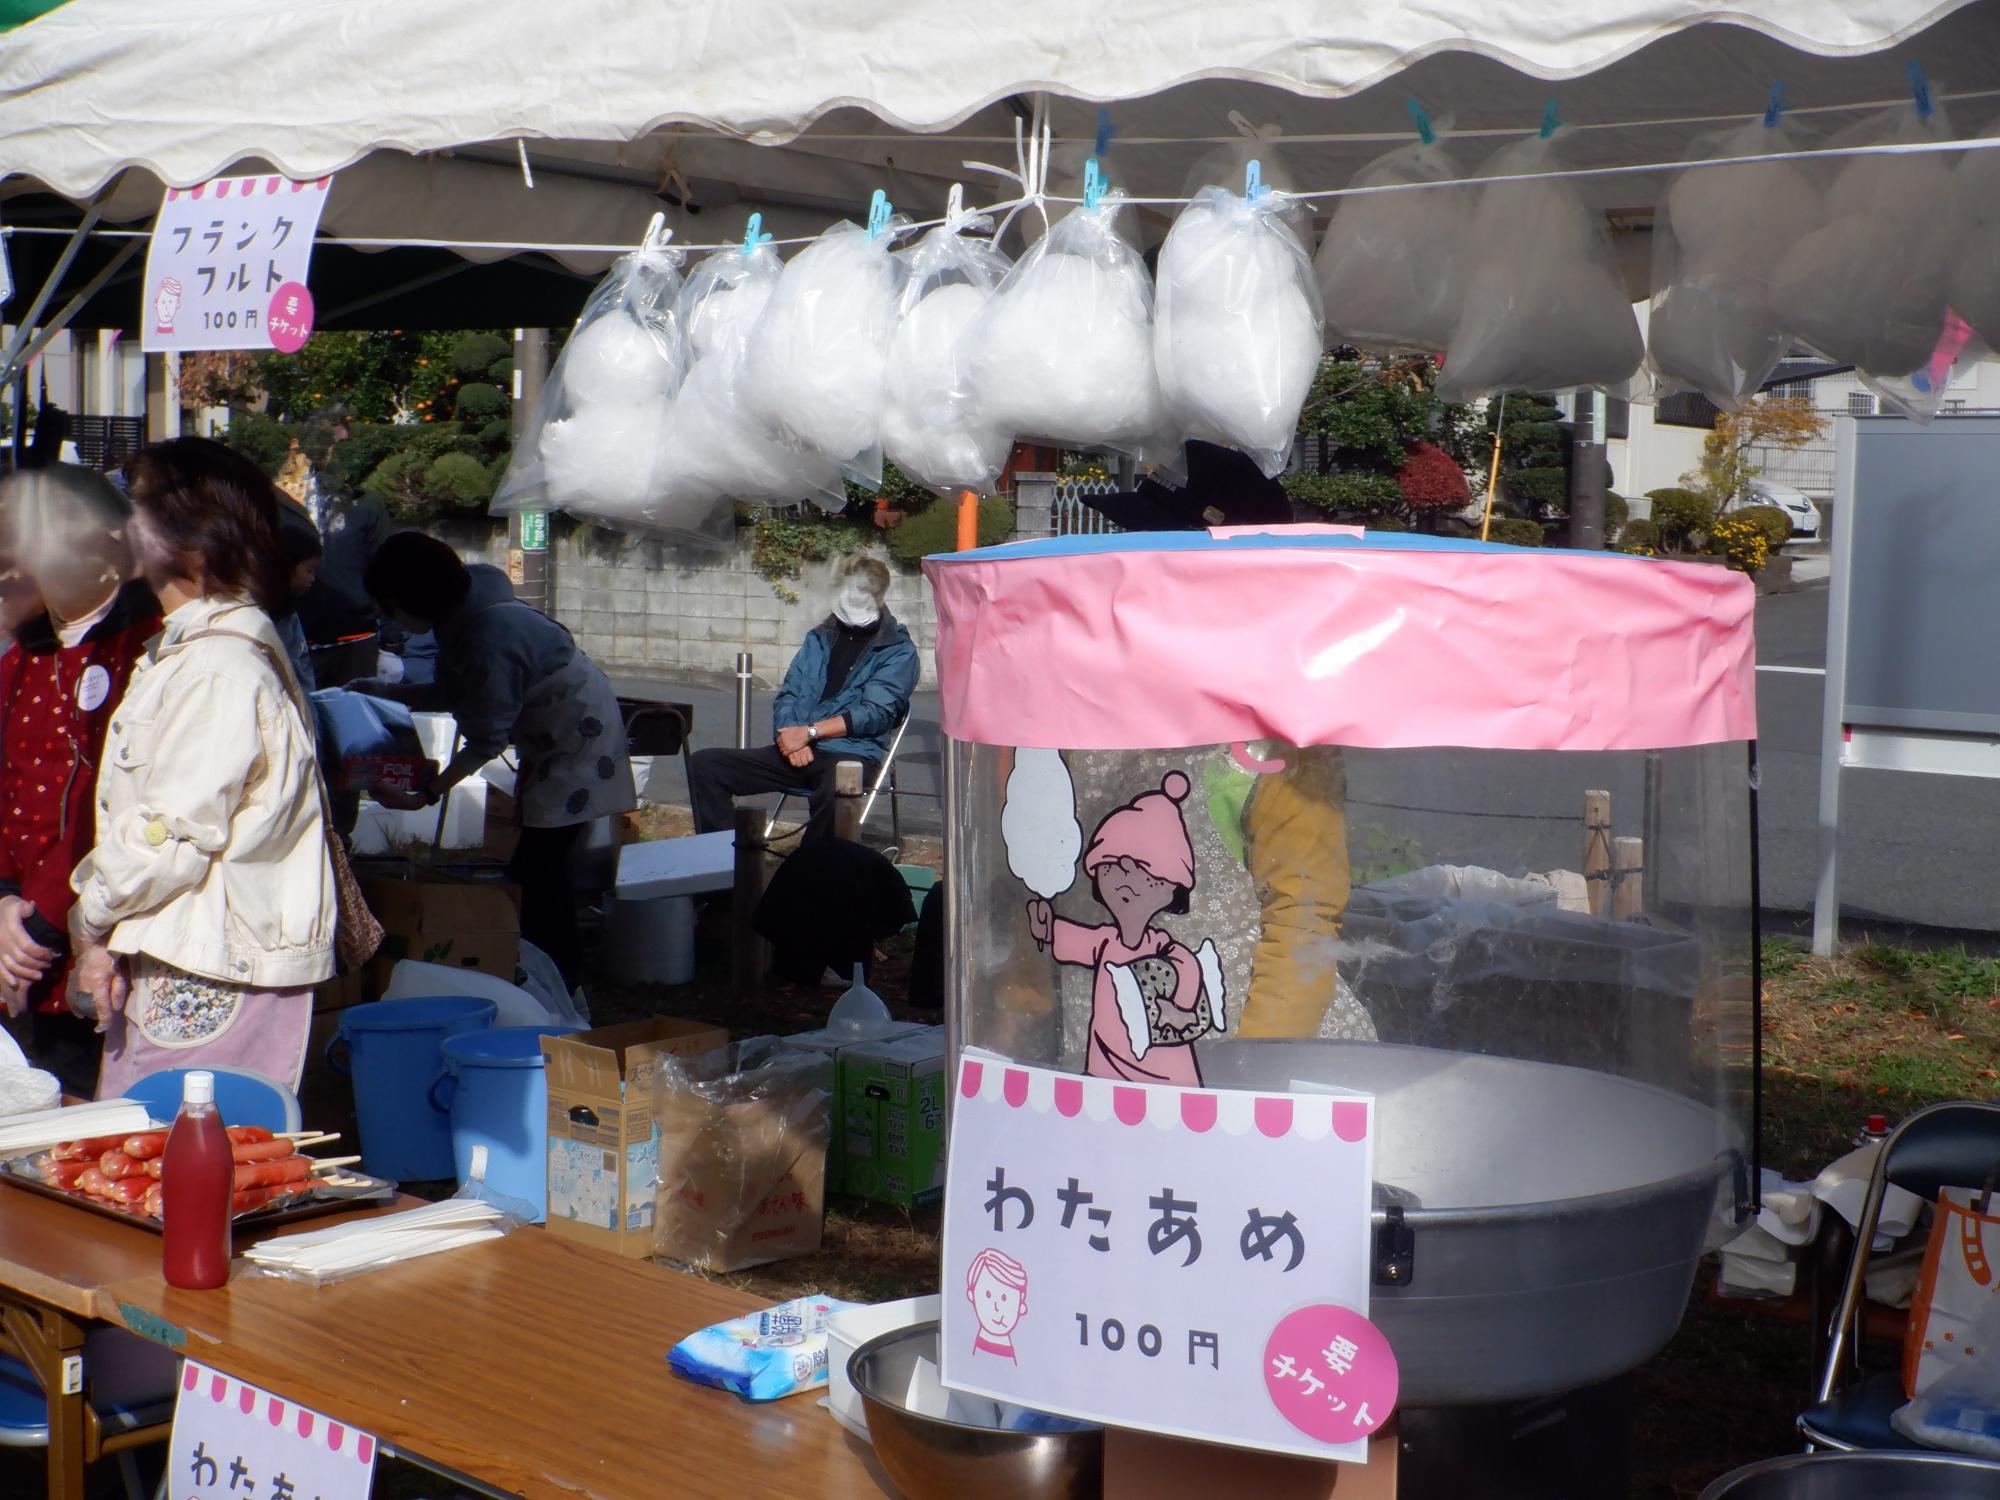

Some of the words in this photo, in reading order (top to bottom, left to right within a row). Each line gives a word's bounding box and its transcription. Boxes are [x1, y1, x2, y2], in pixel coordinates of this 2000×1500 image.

[173, 216, 293, 255] フランク
[198, 260, 283, 296] フルト
[269, 317, 308, 338] チケット
[920, 1095, 940, 1115] 2L
[984, 1166, 1305, 1273] わたあめ
[1321, 1334, 1359, 1376] 要
[1271, 1352, 1375, 1427] チケット
[190, 1441, 321, 1500] わたあ
